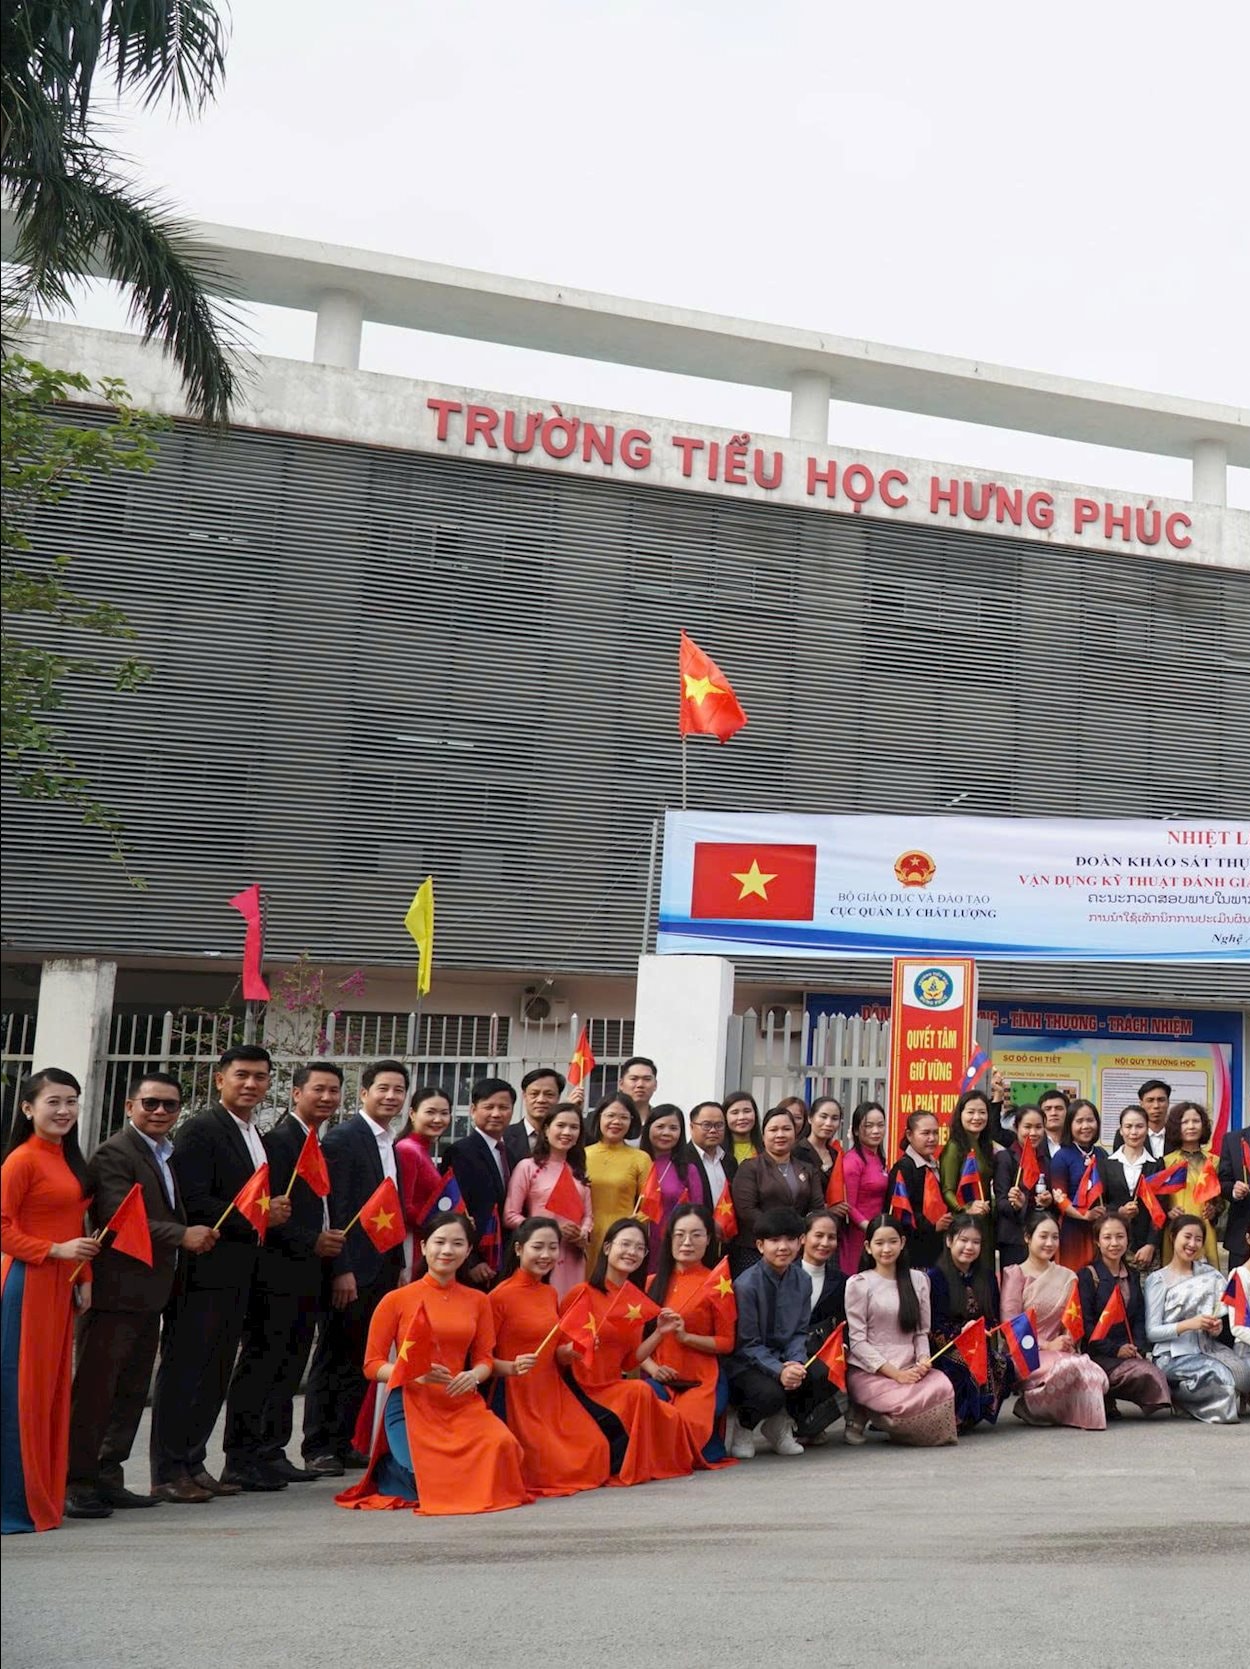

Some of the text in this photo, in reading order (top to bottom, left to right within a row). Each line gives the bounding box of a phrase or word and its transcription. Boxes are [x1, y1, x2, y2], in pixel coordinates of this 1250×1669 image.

[427, 398, 1193, 550] TRƯỜNG TIỂU HỌC HƯNG PHÚC
[1168, 830, 1230, 848] NHIỆT
[1076, 854, 1122, 867] ĐOÀN
[1128, 855, 1176, 868] KHẢO
[1180, 855, 1212, 868] SÁT
[1019, 874, 1051, 888] VẬN
[1055, 875, 1097, 889] DỤNG
[1102, 874, 1123, 886] KỸ
[1127, 875, 1179, 889] THUẬT
[1182, 875, 1225, 887] ĐÁNH
[838, 890, 990, 905] BỘ GIÁO DỤC VÀ ĐÀO TẠO
[830, 906, 997, 920] CỤC QUẢN LÝ CHẤT LƯỢNG
[1211, 933, 1243, 945] Nghệ
[1009, 1009, 1042, 1029] TÌNH
[1044, 1012, 1097, 1032] THƯƠNG
[1107, 1013, 1149, 1034] TRÁCH
[1150, 1015, 1193, 1038] NHIỆM
[907, 1024, 958, 1051] QUYẾT TÂM
[1003, 1054, 1015, 1062] SƠ
[1029, 1055, 1043, 1063] CHI
[1129, 1057, 1146, 1066] QUY
[909, 1058, 953, 1081] GIỮ VỮNG
[901, 1090, 959, 1113] VÀ PHÁT HUY
